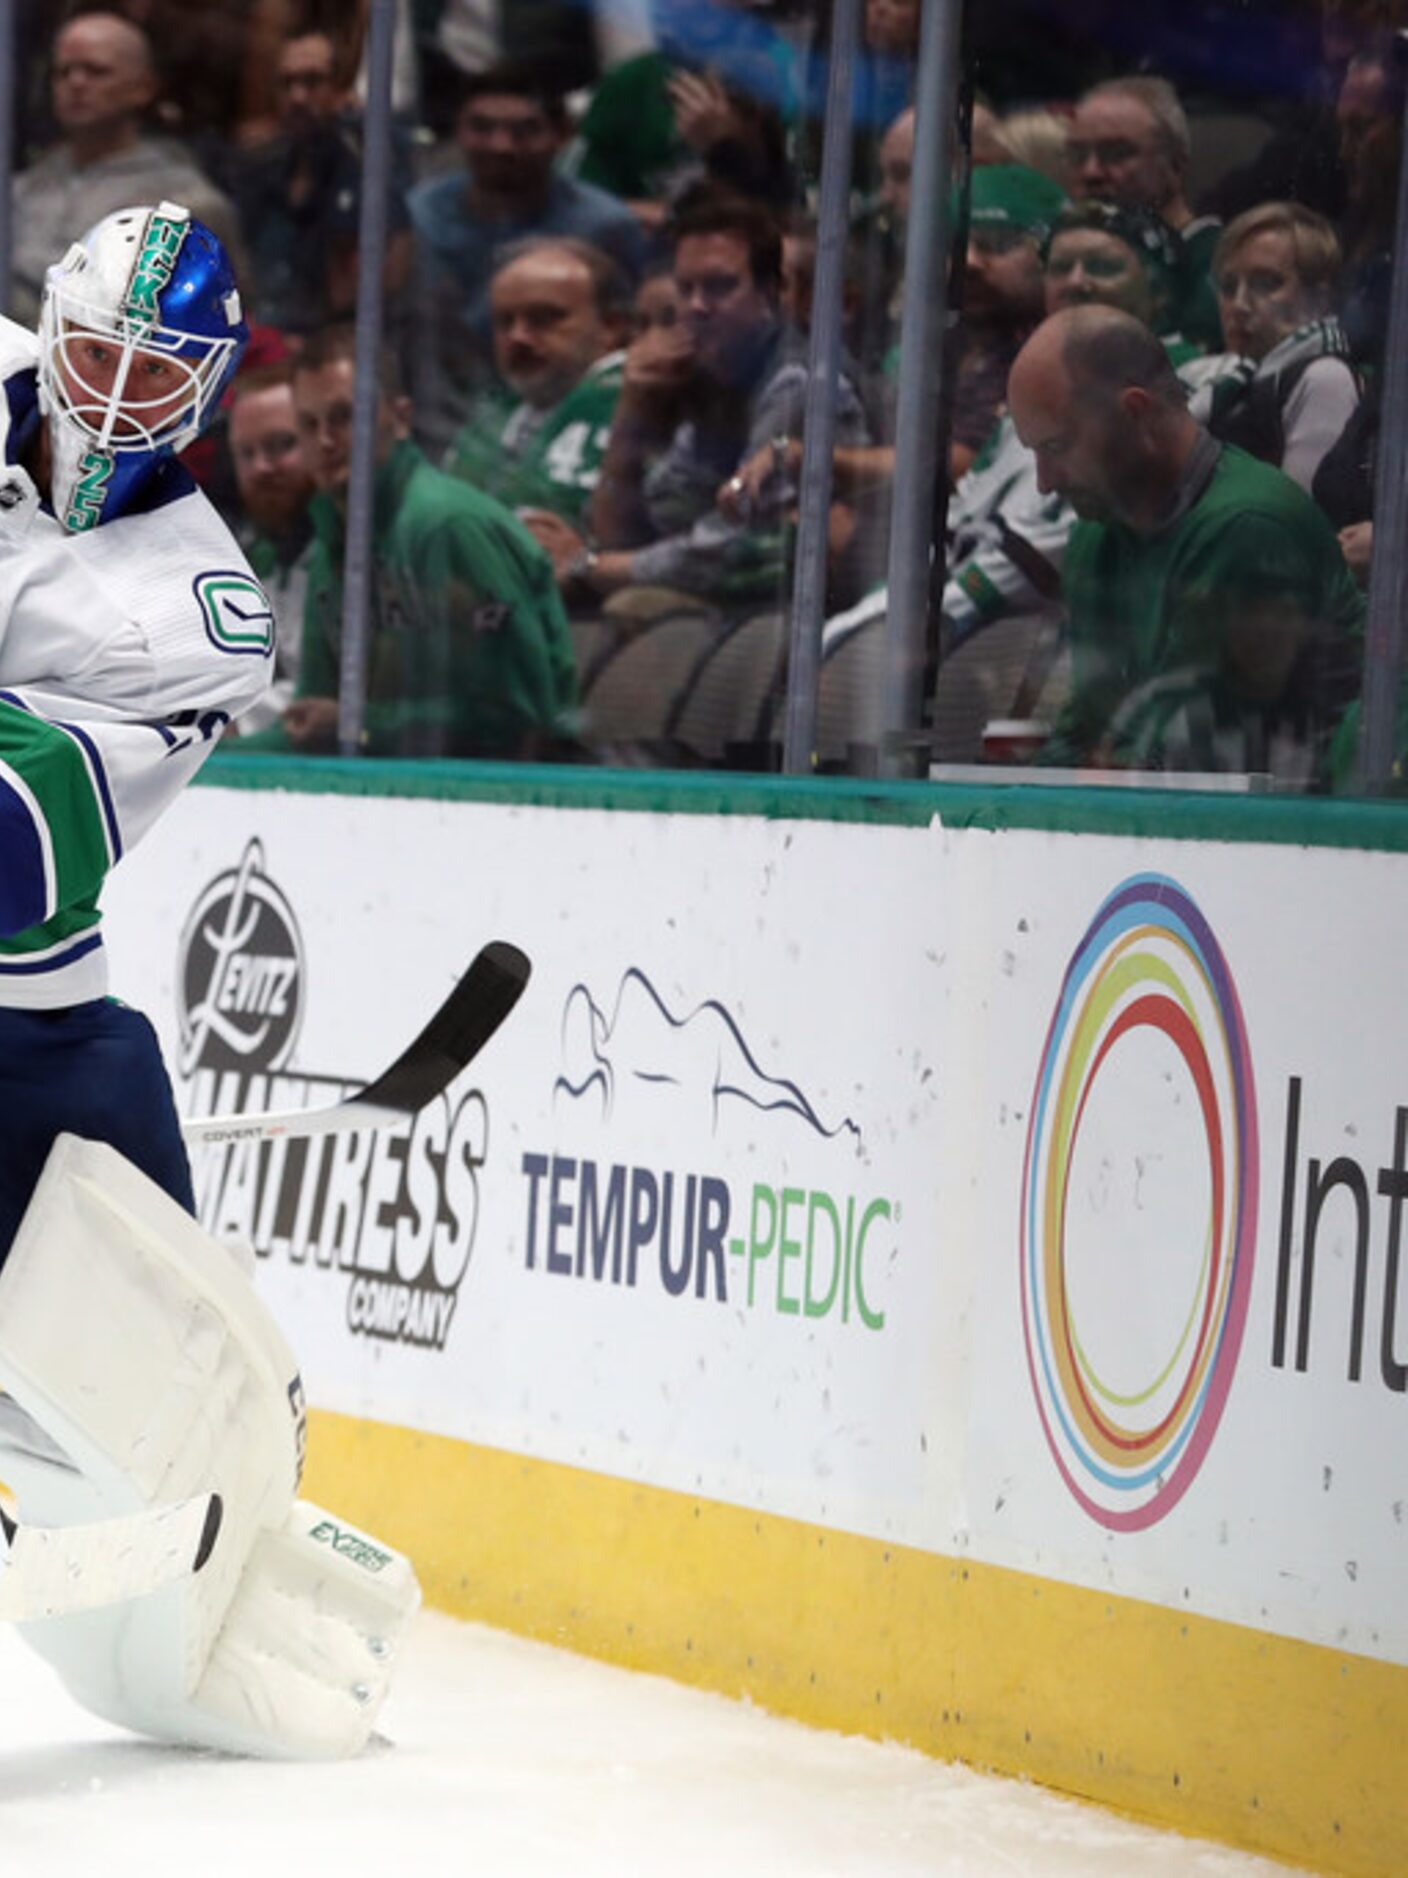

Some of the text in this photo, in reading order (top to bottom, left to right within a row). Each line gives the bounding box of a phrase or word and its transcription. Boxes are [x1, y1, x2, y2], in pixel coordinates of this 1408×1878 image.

[66, 451, 113, 535] 25
[522, 1151, 892, 1331] TEMPUR-PEDIC
[347, 1276, 458, 1350] COMPANY
